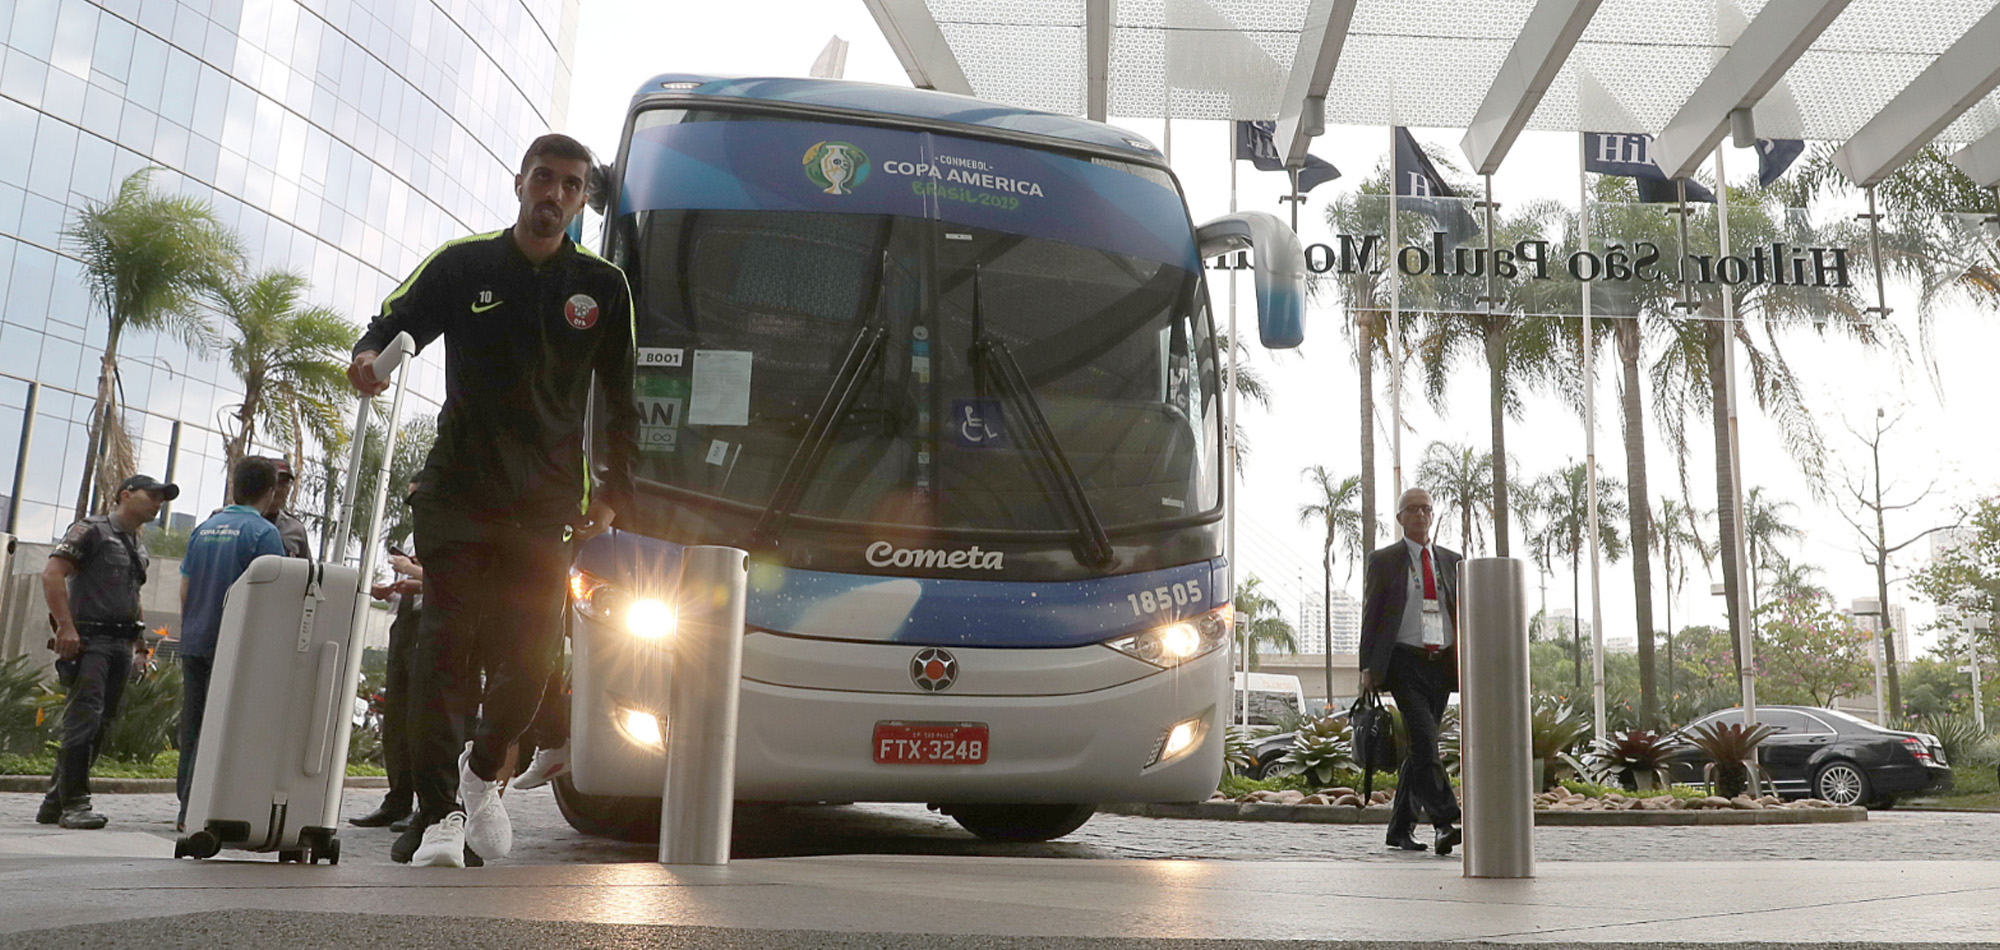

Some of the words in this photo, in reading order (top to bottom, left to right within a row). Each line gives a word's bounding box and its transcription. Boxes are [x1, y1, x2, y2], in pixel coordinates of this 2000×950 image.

[1596, 133, 1655, 166] Hil
[883, 160, 943, 180] COPA
[946, 168, 1044, 198] AMERICA
[479, 291, 492, 303] 10
[646, 352, 679, 364] B001
[865, 541, 1005, 571] Cometa
[1127, 579, 1203, 617] 18505
